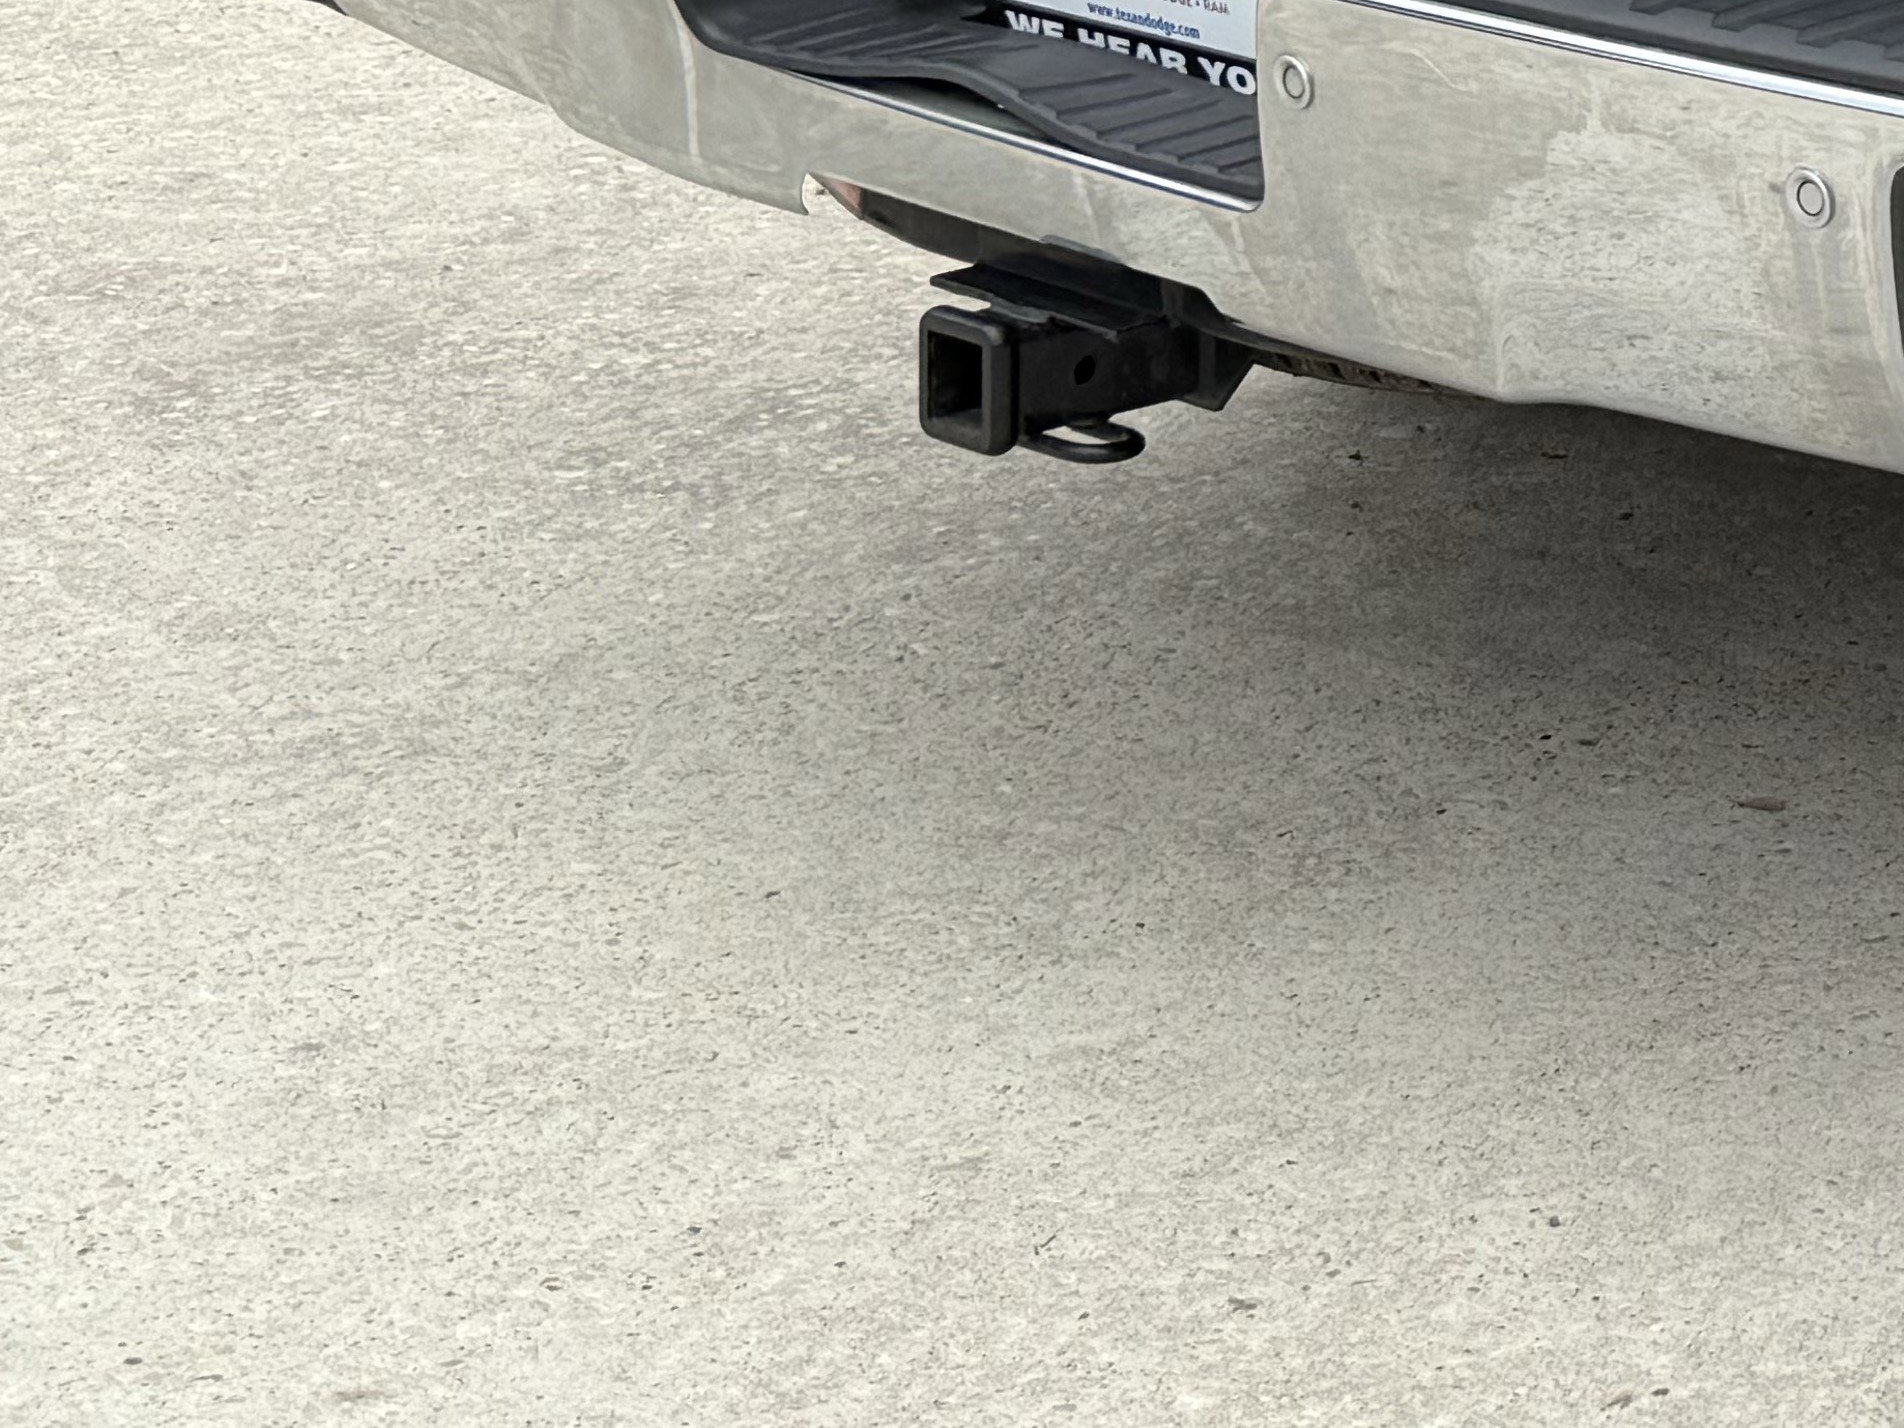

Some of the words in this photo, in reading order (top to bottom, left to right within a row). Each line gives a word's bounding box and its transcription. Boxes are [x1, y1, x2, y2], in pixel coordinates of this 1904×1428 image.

[1086, 1, 1201, 40] www.texandodge.com
[1004, 10, 1065, 39] WE
[1077, 27, 1188, 75] HEAR
[1198, 56, 1257, 95] YO
